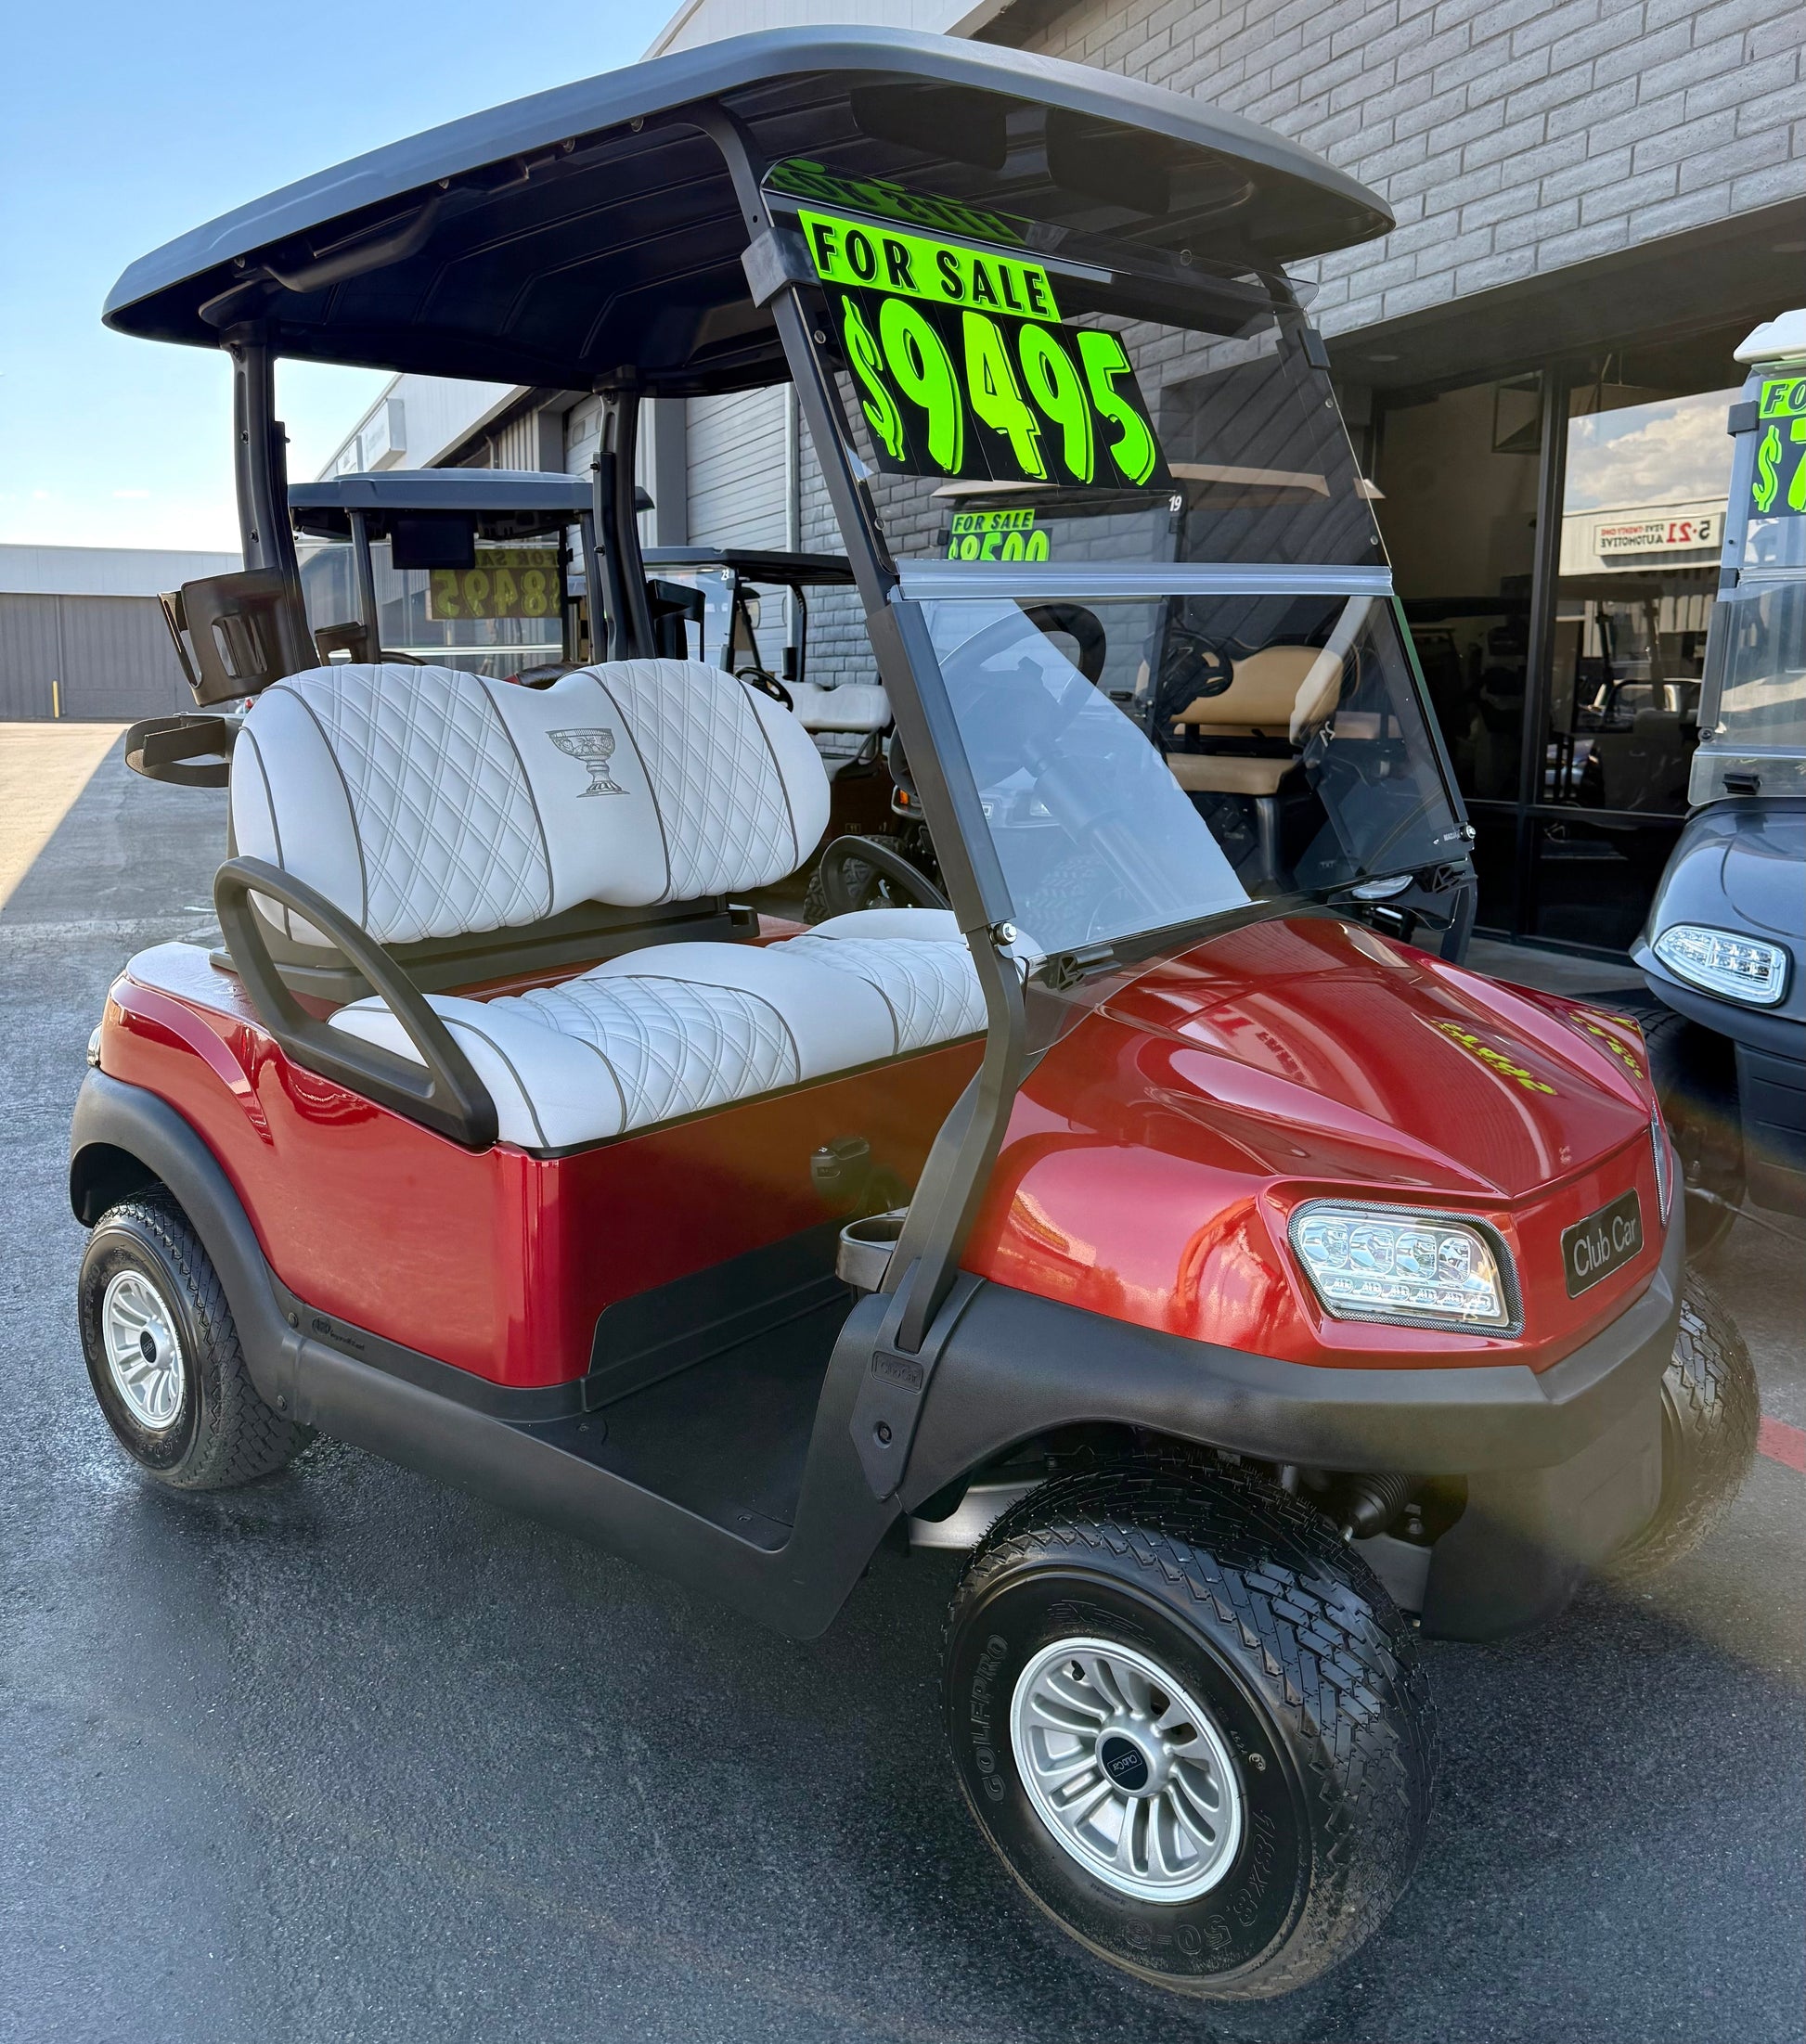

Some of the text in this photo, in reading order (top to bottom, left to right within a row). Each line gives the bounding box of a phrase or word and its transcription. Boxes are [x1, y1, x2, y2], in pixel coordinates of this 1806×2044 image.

[810, 222, 1051, 317] FOR SALE
[841, 294, 1156, 486] $9495
[953, 511, 1033, 533] FOR SALE
[1168, 495, 1183, 512] 19
[1573, 1215, 1636, 1277] Club Car
[970, 1634, 1009, 1802] GOLFPRO
